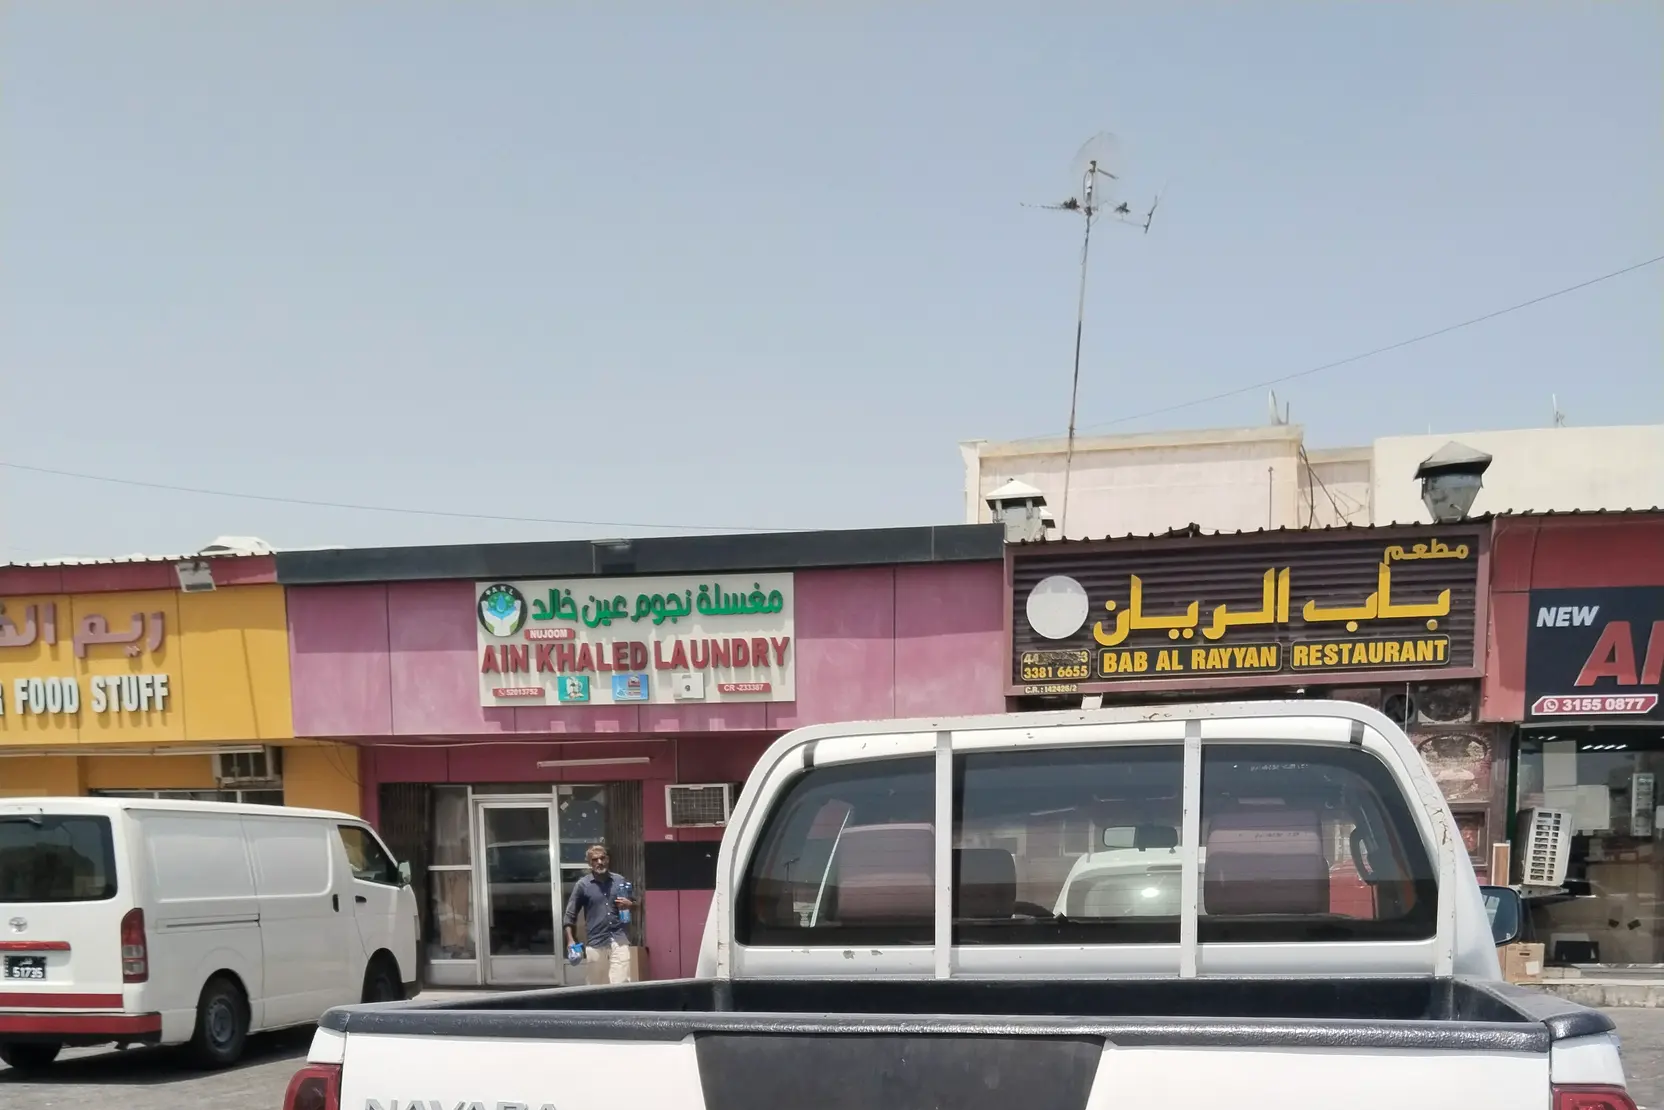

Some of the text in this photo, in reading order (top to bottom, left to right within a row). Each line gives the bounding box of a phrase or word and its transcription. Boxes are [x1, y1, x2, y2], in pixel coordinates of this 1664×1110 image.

[1383, 538, 1469, 564] مطعم
[531, 582, 784, 628] مغسلة نجوم عين خالد
[1093, 561, 1451, 646] باب الريان
[1536, 606, 1600, 627] NEW
[73, 611, 165, 658] ريم
[529, 629, 568, 639] NUJOOM
[481, 636, 790, 674] AIN KHALED LAUNDRY
[1024, 665, 1088, 679] 3381 6655
[1103, 652, 1148, 673] BAB
[1155, 651, 1183, 671] AL
[1191, 646, 1277, 669] RAYYAN
[1294, 639, 1448, 666] RESTAURANT
[14, 676, 79, 715] FOOD
[90, 673, 169, 713] STUFF
[1562, 697, 1645, 712] 3155 0877
